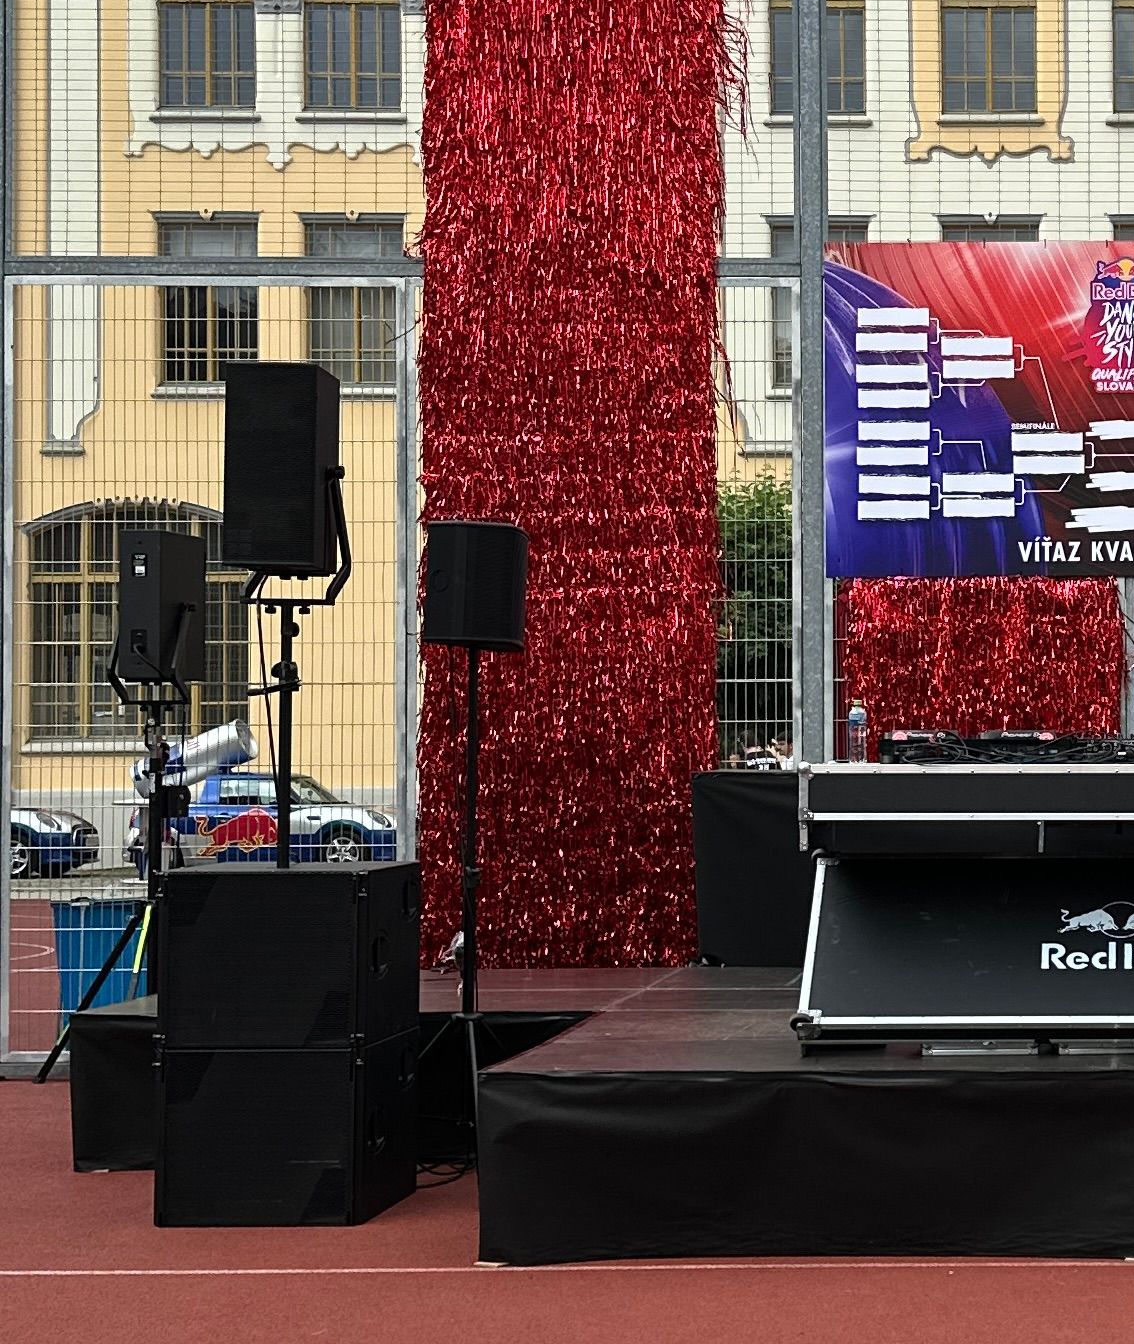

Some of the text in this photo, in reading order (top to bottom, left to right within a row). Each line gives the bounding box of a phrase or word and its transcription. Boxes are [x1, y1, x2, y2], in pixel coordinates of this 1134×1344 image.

[1092, 282, 1127, 301] Red
[1017, 536, 1081, 562] VÍŤAZ
[1041, 941, 1117, 970] Red
